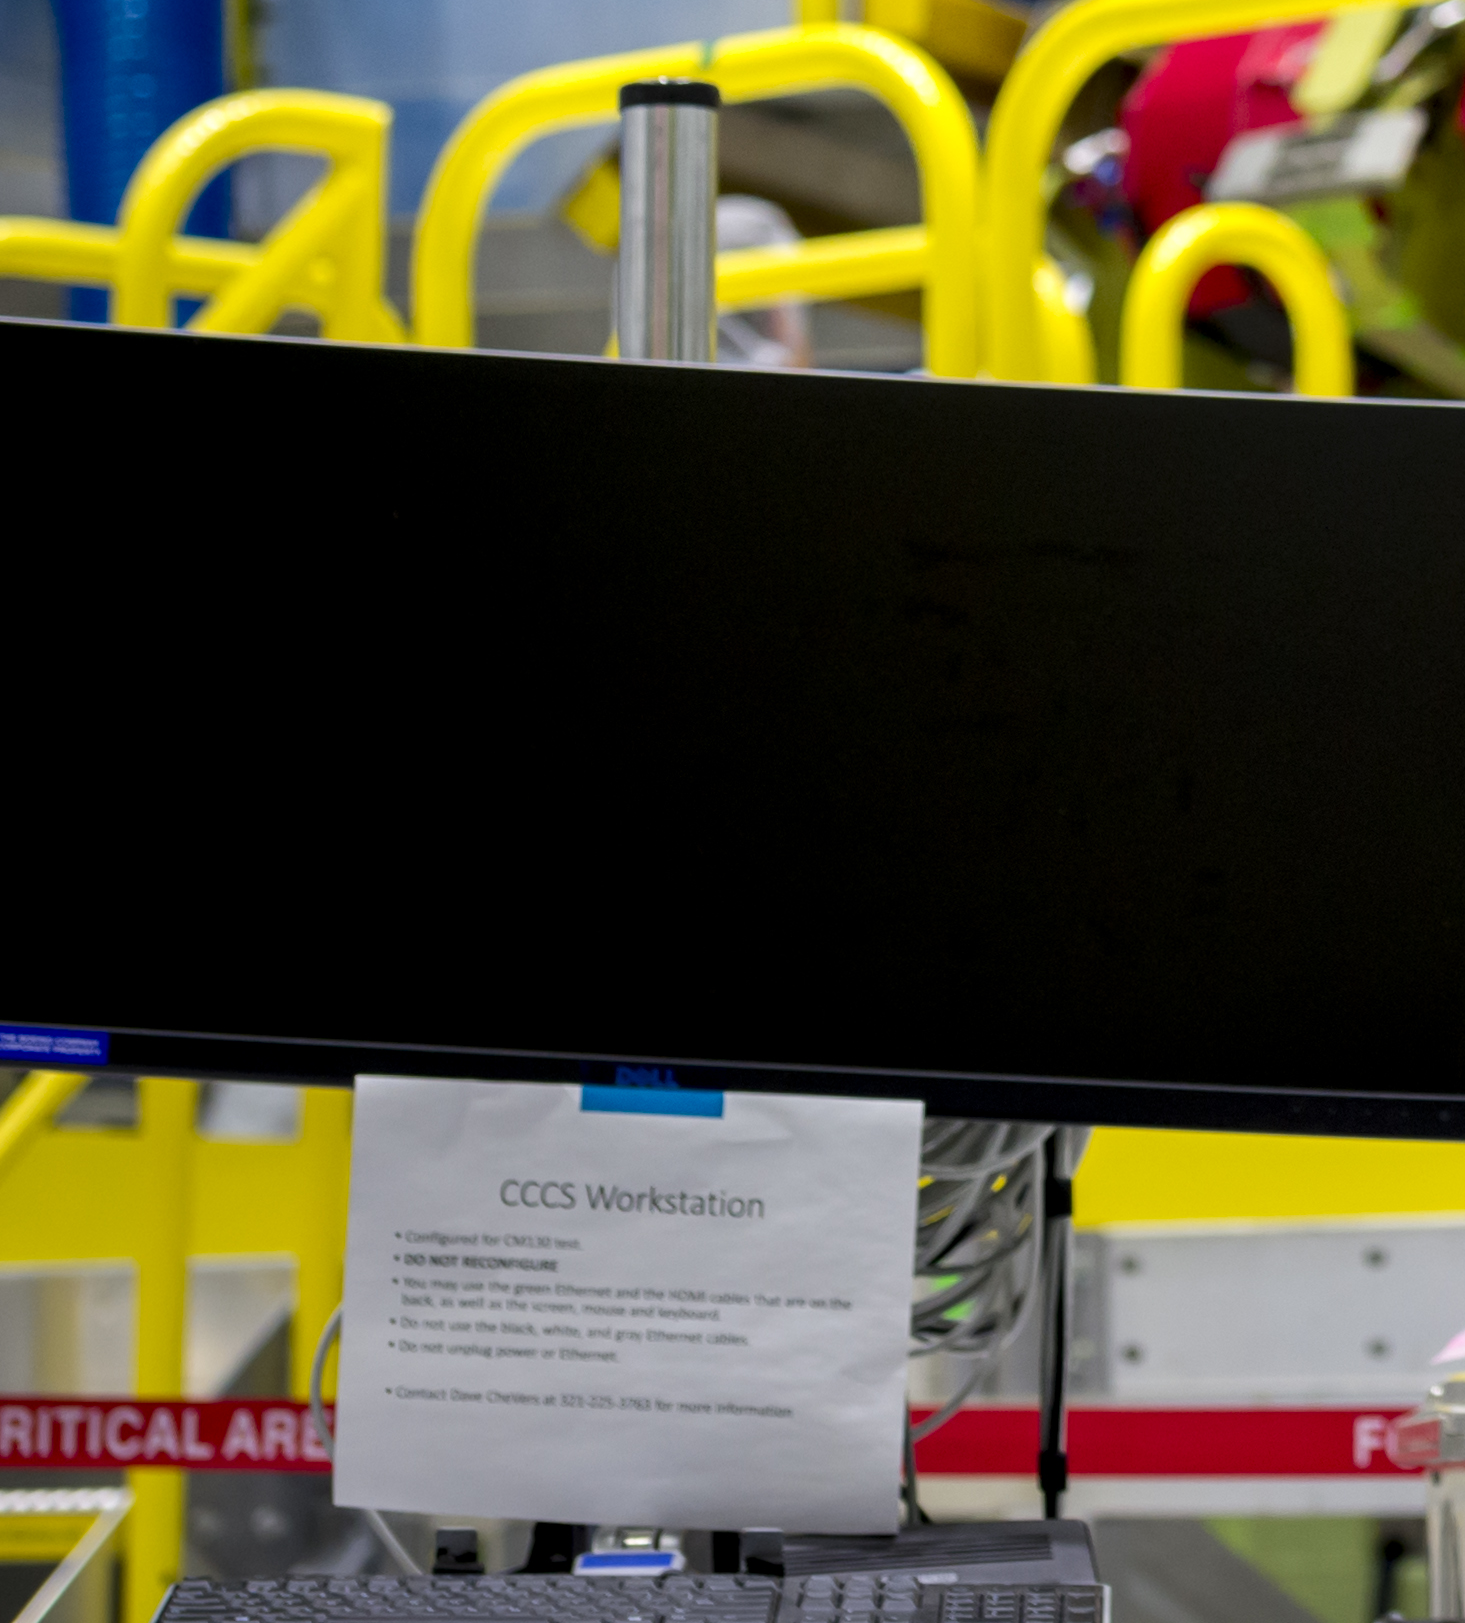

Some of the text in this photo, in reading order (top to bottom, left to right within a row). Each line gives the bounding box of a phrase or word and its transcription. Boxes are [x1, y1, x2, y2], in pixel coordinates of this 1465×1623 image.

[499, 1178, 766, 1220] CCCS Workstation
[404, 1230, 478, 1247] Configured
[481, 1233, 500, 1247] for
[403, 1253, 559, 1273] DO NOT RECONFIGURE
[404, 1277, 427, 1289] You
[431, 1279, 458, 1292] may
[461, 1281, 484, 1292] use
[487, 1281, 510, 1293] the
[513, 1284, 551, 1296] green
[554, 1282, 612, 1298] Ethernet
[616, 1286, 640, 1299] and
[643, 1287, 665, 1300] the
[709, 1291, 749, 1305] cables
[753, 1292, 781, 1307] that
[785, 1296, 806, 1308] are
[829, 1297, 853, 1311] the
[440, 1297, 454, 1308] as
[458, 1296, 485, 1309] well
[489, 1299, 503, 1309] as
[506, 1298, 529, 1312] the
[581, 1303, 627, 1316] mouse
[630, 1305, 656, 1318] and
[400, 1315, 419, 1329] Do
[421, 1319, 445, 1331] not
[448, 1321, 471, 1332] use
[474, 1320, 498, 1333] the
[586, 1327, 612, 1339] and
[645, 1328, 703, 1344] Ethernet
[398, 1338, 418, 1353] Do
[420, 1342, 444, 1354] not
[446, 1343, 493, 1358] unplug
[495, 1346, 537, 1358] power
[540, 1349, 556, 1359] or
[394, 1385, 448, 1401] Contact
[542, 1393, 557, 1407] at
[655, 1397, 673, 1412] for
[676, 1401, 713, 1415] more
